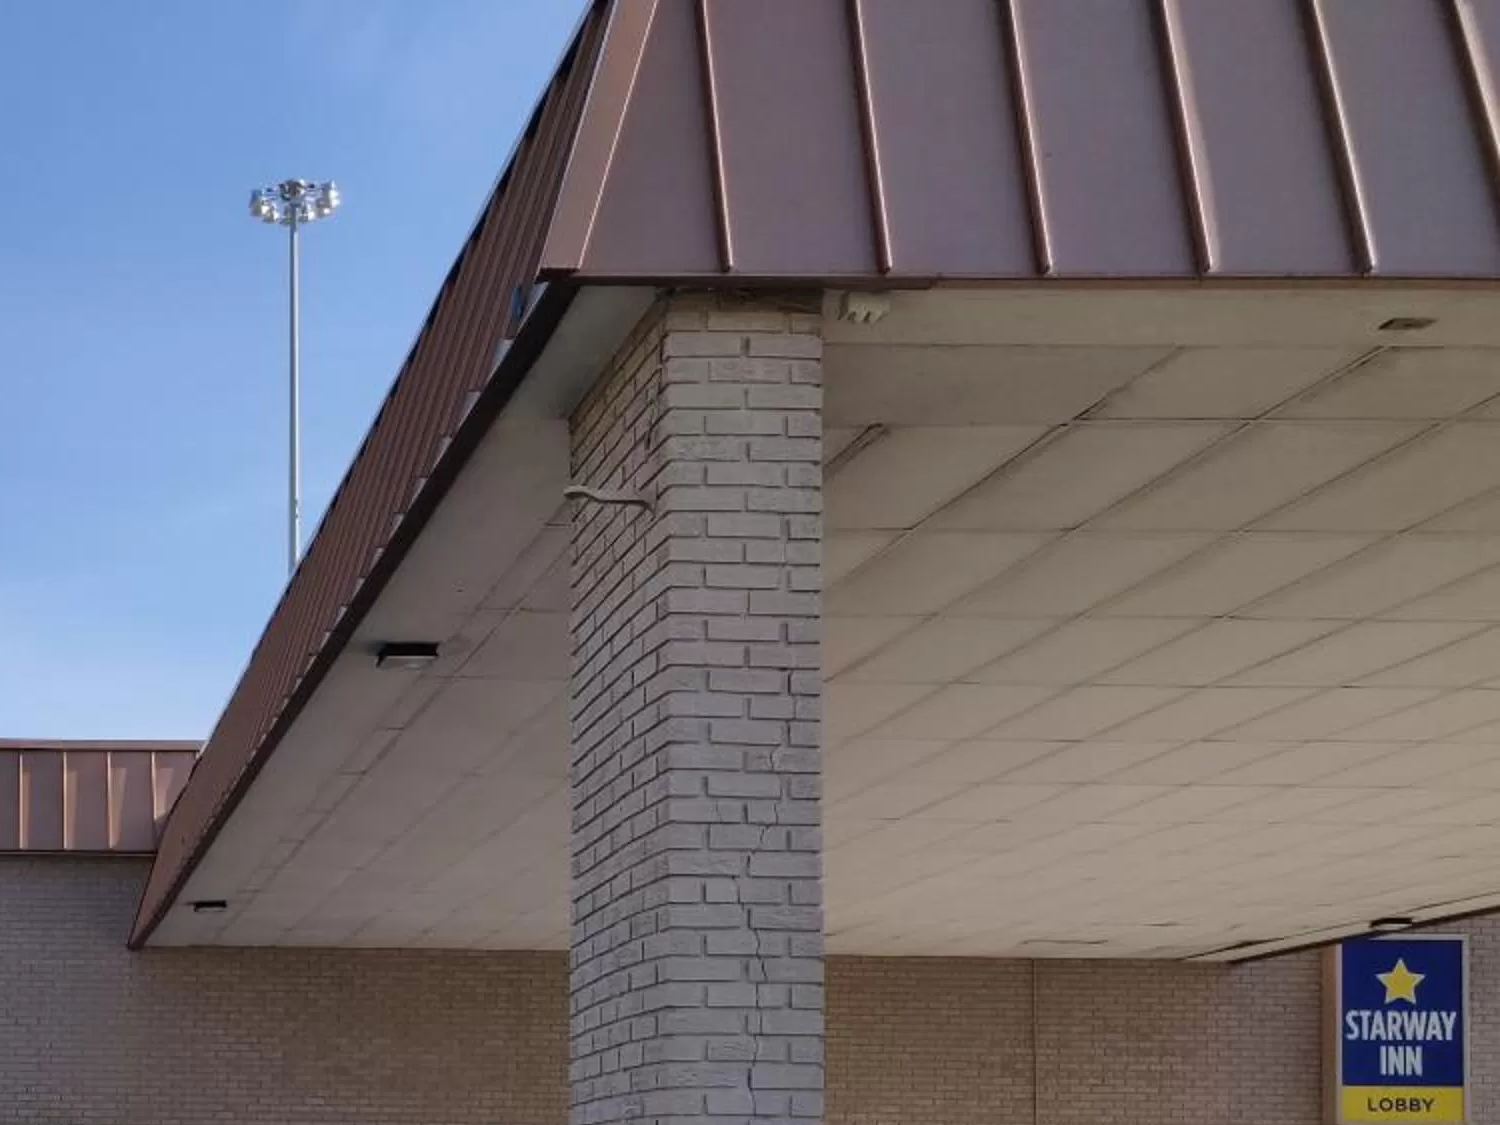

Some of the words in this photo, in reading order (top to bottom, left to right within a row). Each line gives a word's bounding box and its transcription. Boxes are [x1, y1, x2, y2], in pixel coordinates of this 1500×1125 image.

[1345, 1010, 1457, 1041] STARWAY
[1379, 1045, 1423, 1076] INN
[1367, 1098, 1434, 1112] LOBBY
